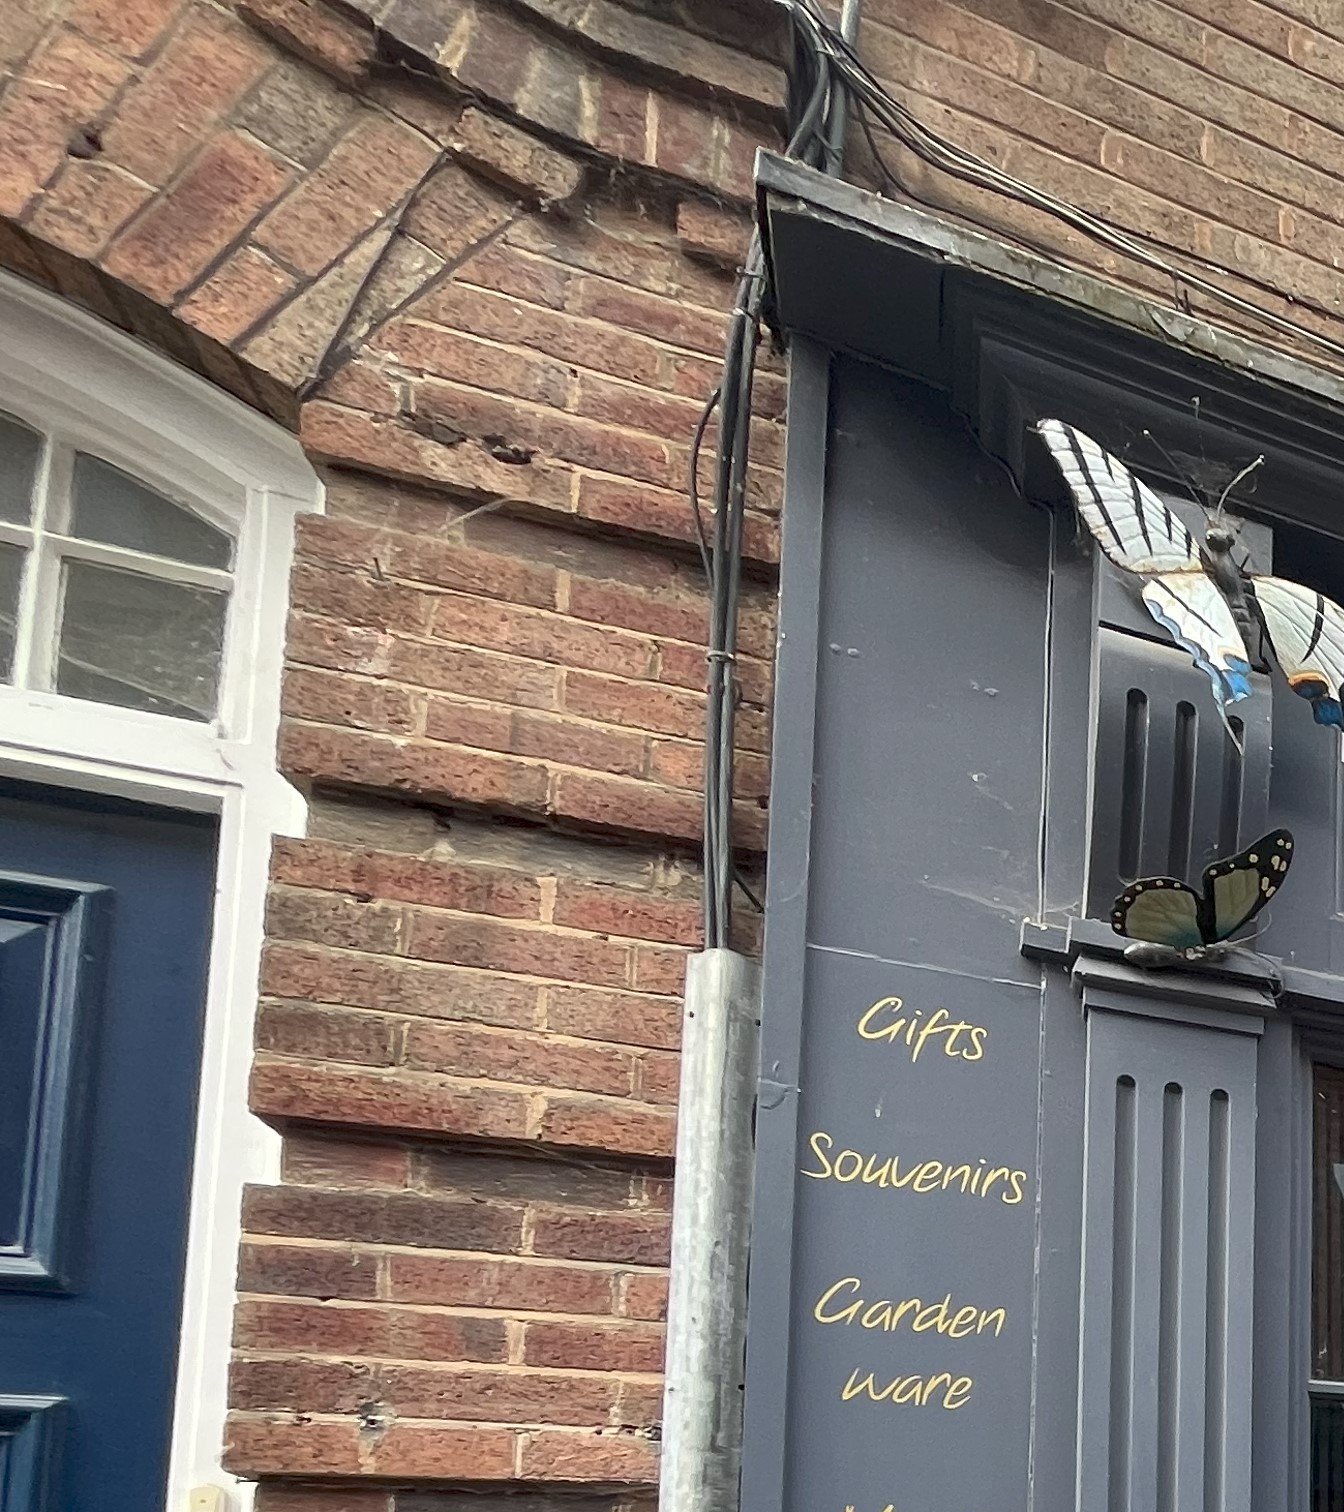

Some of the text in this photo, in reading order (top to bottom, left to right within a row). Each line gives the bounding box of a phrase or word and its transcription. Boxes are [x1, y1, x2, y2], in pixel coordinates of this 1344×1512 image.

[858, 997, 985, 1061] Gifts
[801, 1132, 1028, 1205] Souvenirs
[814, 1277, 1007, 1338] Garden
[840, 1367, 973, 1410] ware
